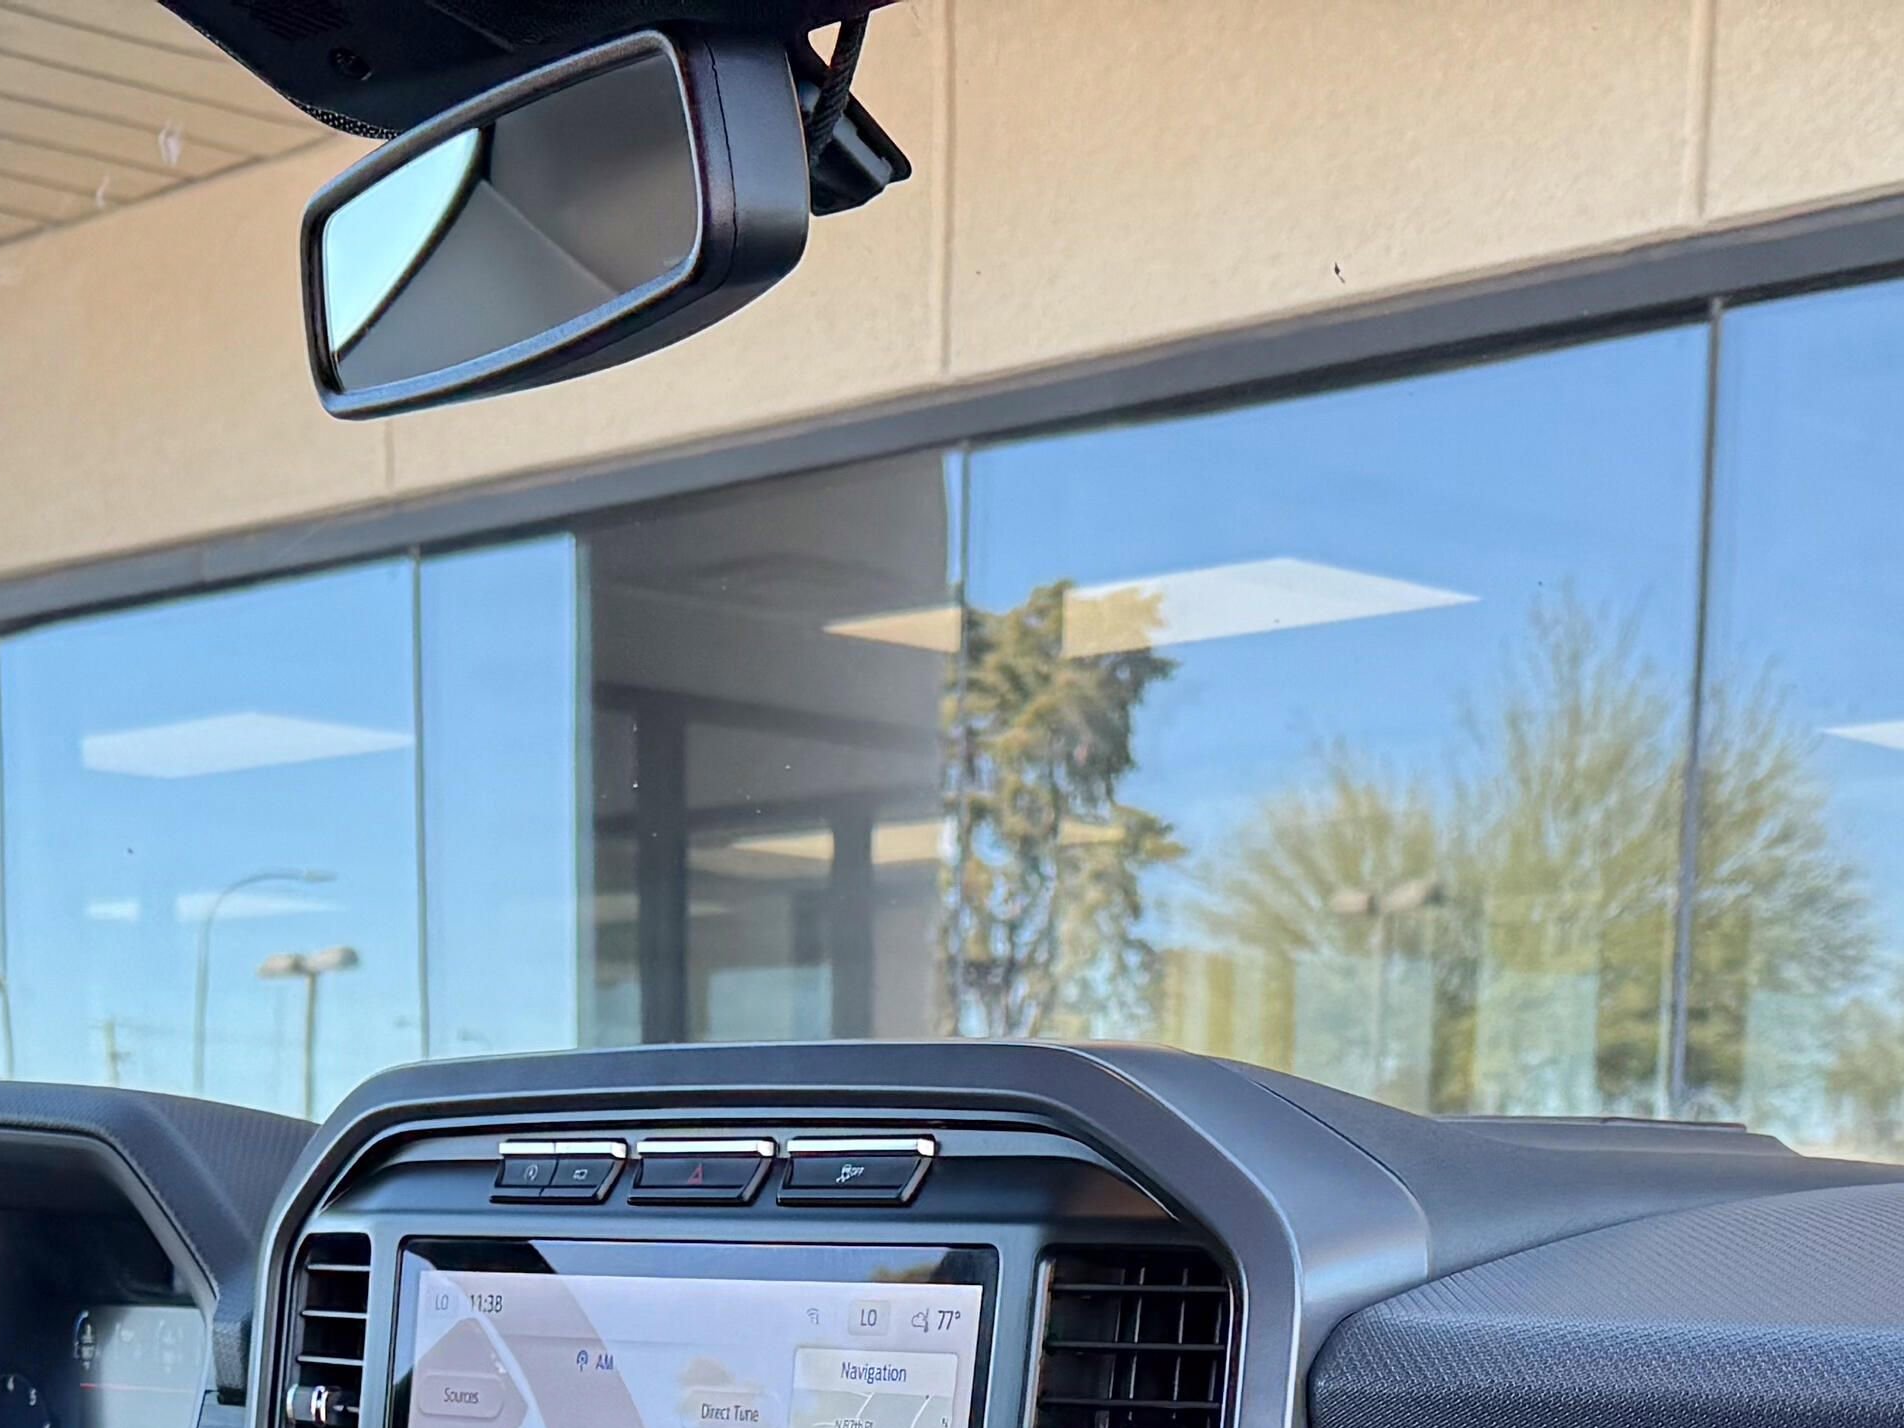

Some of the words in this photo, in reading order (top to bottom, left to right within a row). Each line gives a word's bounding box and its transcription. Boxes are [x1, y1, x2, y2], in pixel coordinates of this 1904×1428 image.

[469, 1293, 504, 1313] 11:38
[859, 1307, 879, 1328] LO
[595, 1353, 615, 1371] AM
[840, 1361, 908, 1385] Navigation
[443, 1386, 480, 1405] Sources
[700, 1404, 731, 1422] Direct
[733, 1405, 760, 1424] Tune
